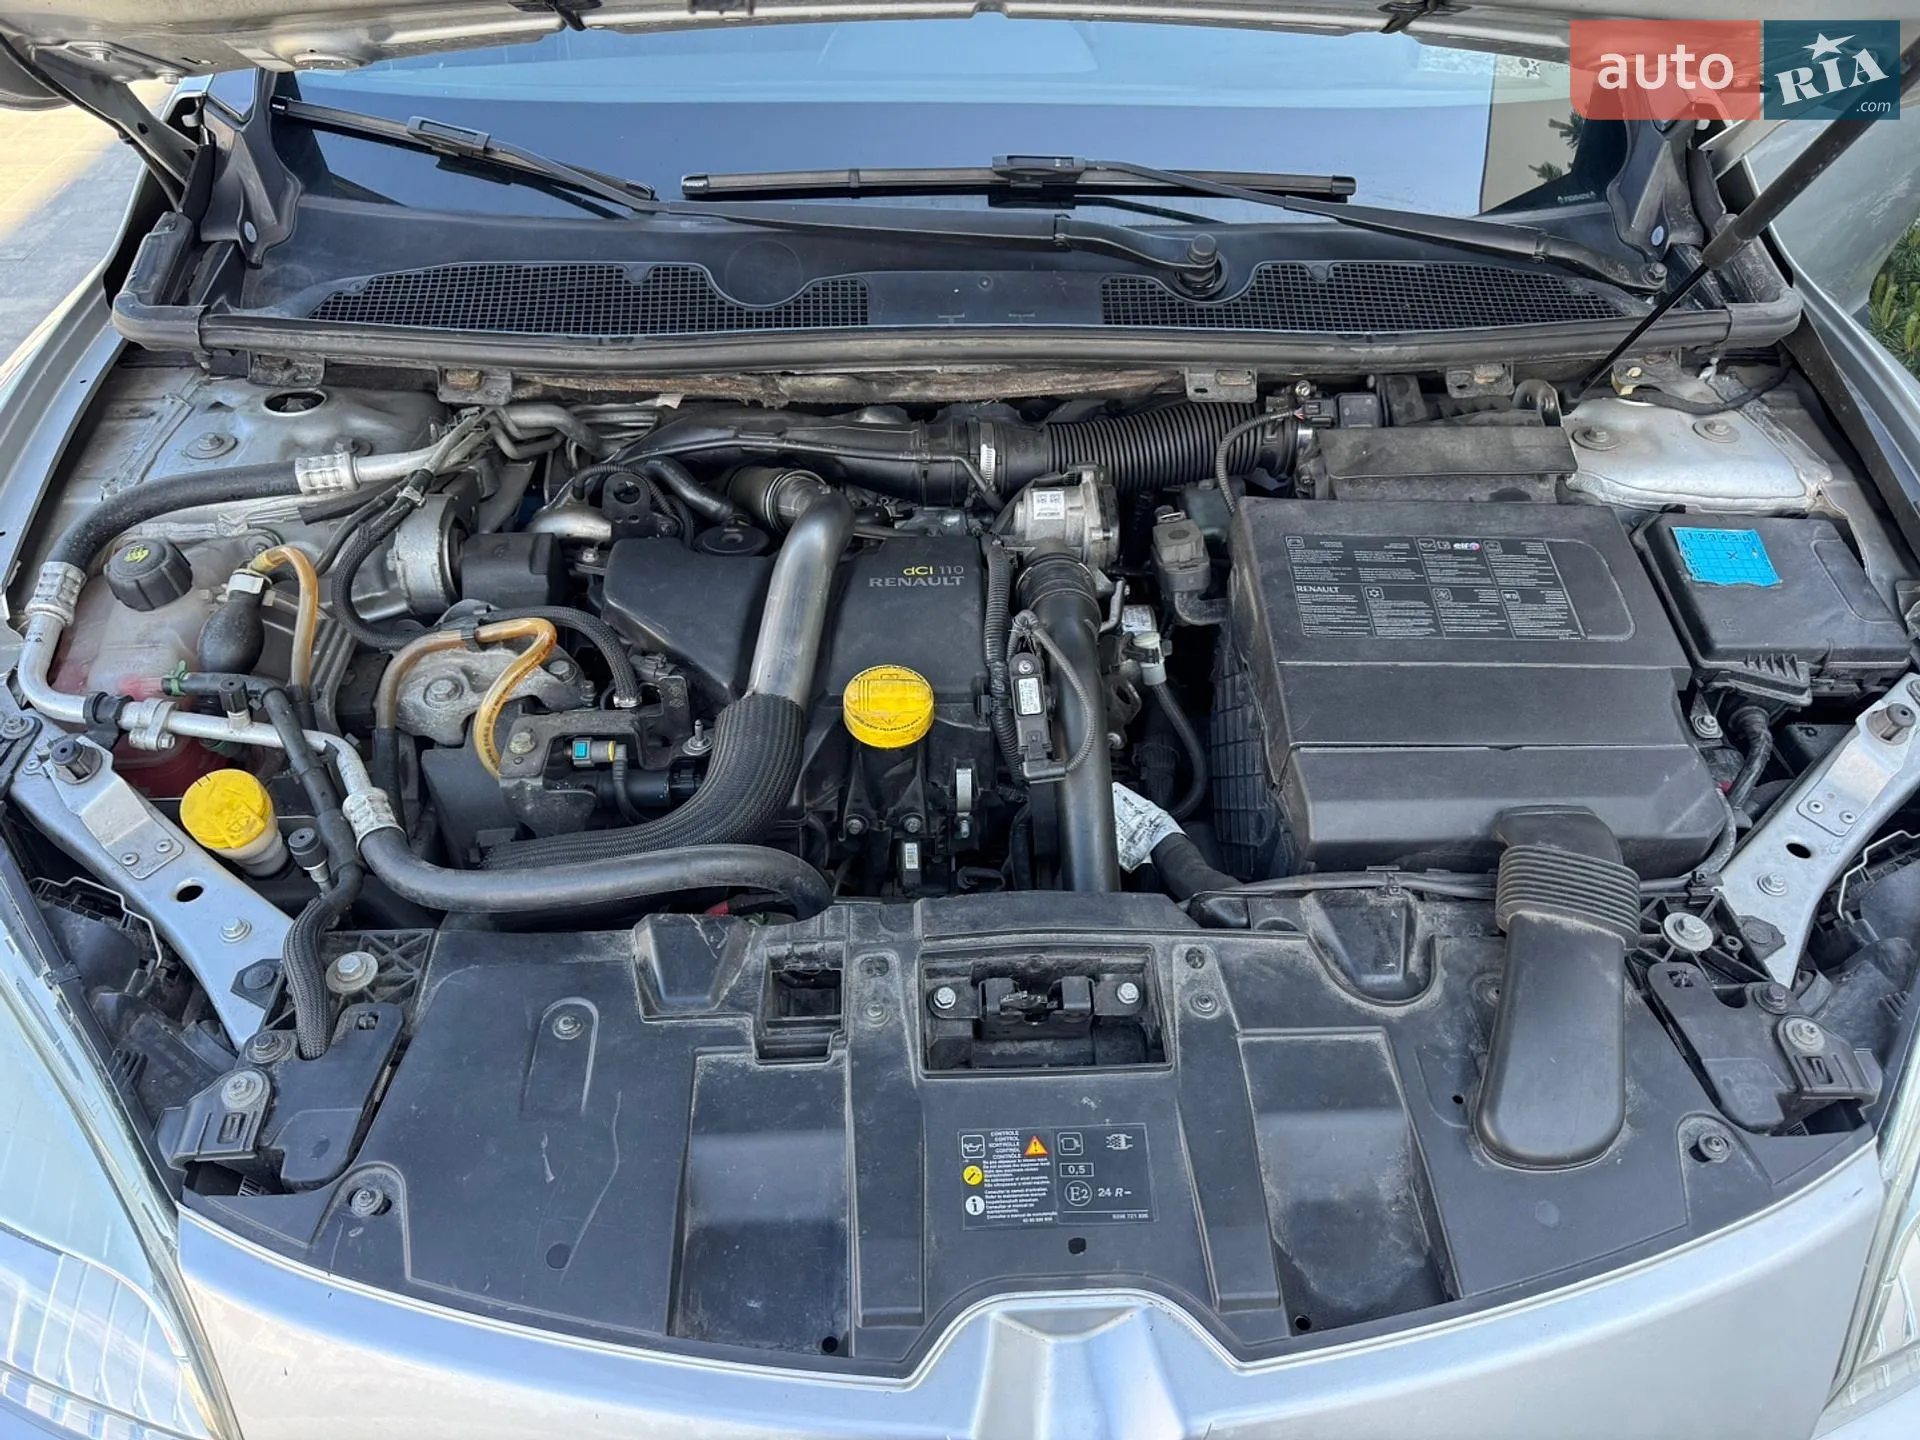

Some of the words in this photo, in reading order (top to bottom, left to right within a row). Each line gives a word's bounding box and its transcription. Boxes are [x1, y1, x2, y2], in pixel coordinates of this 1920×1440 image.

[939, 565, 964, 575] 110
[868, 576, 965, 588] RENAULT
[1068, 1165, 1085, 1175] 0,5
[1097, 1188, 1112, 1197] 24
